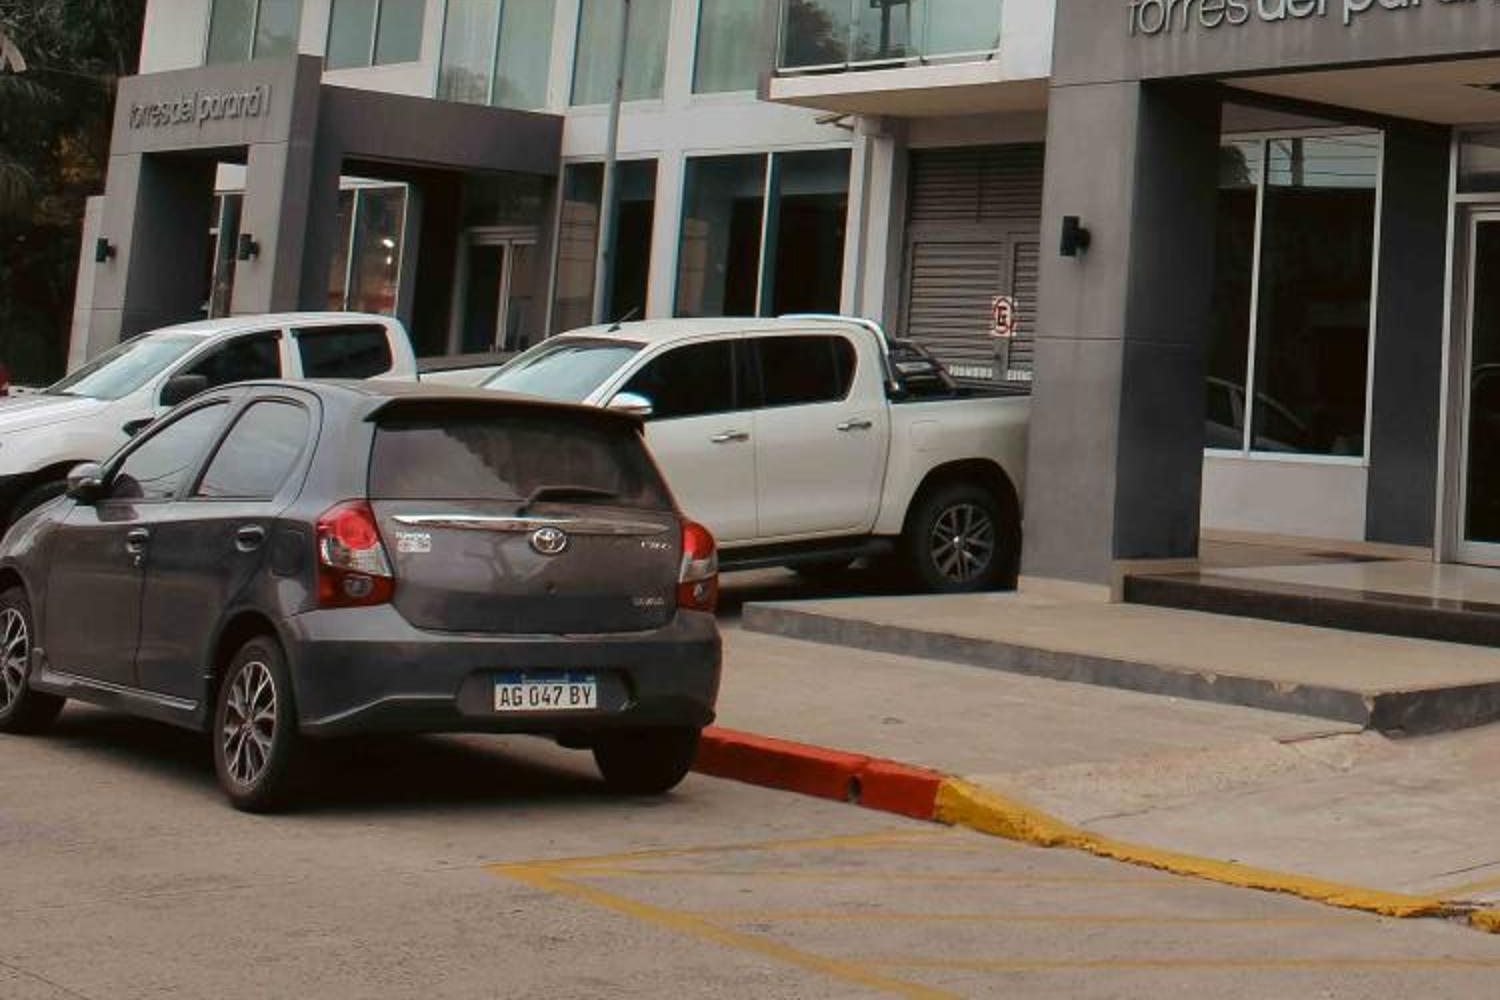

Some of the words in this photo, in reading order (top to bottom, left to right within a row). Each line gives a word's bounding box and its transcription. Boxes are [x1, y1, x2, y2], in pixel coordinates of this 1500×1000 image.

[500, 686, 523, 707] AG
[529, 685, 563, 706] 047
[569, 685, 592, 705] BY
